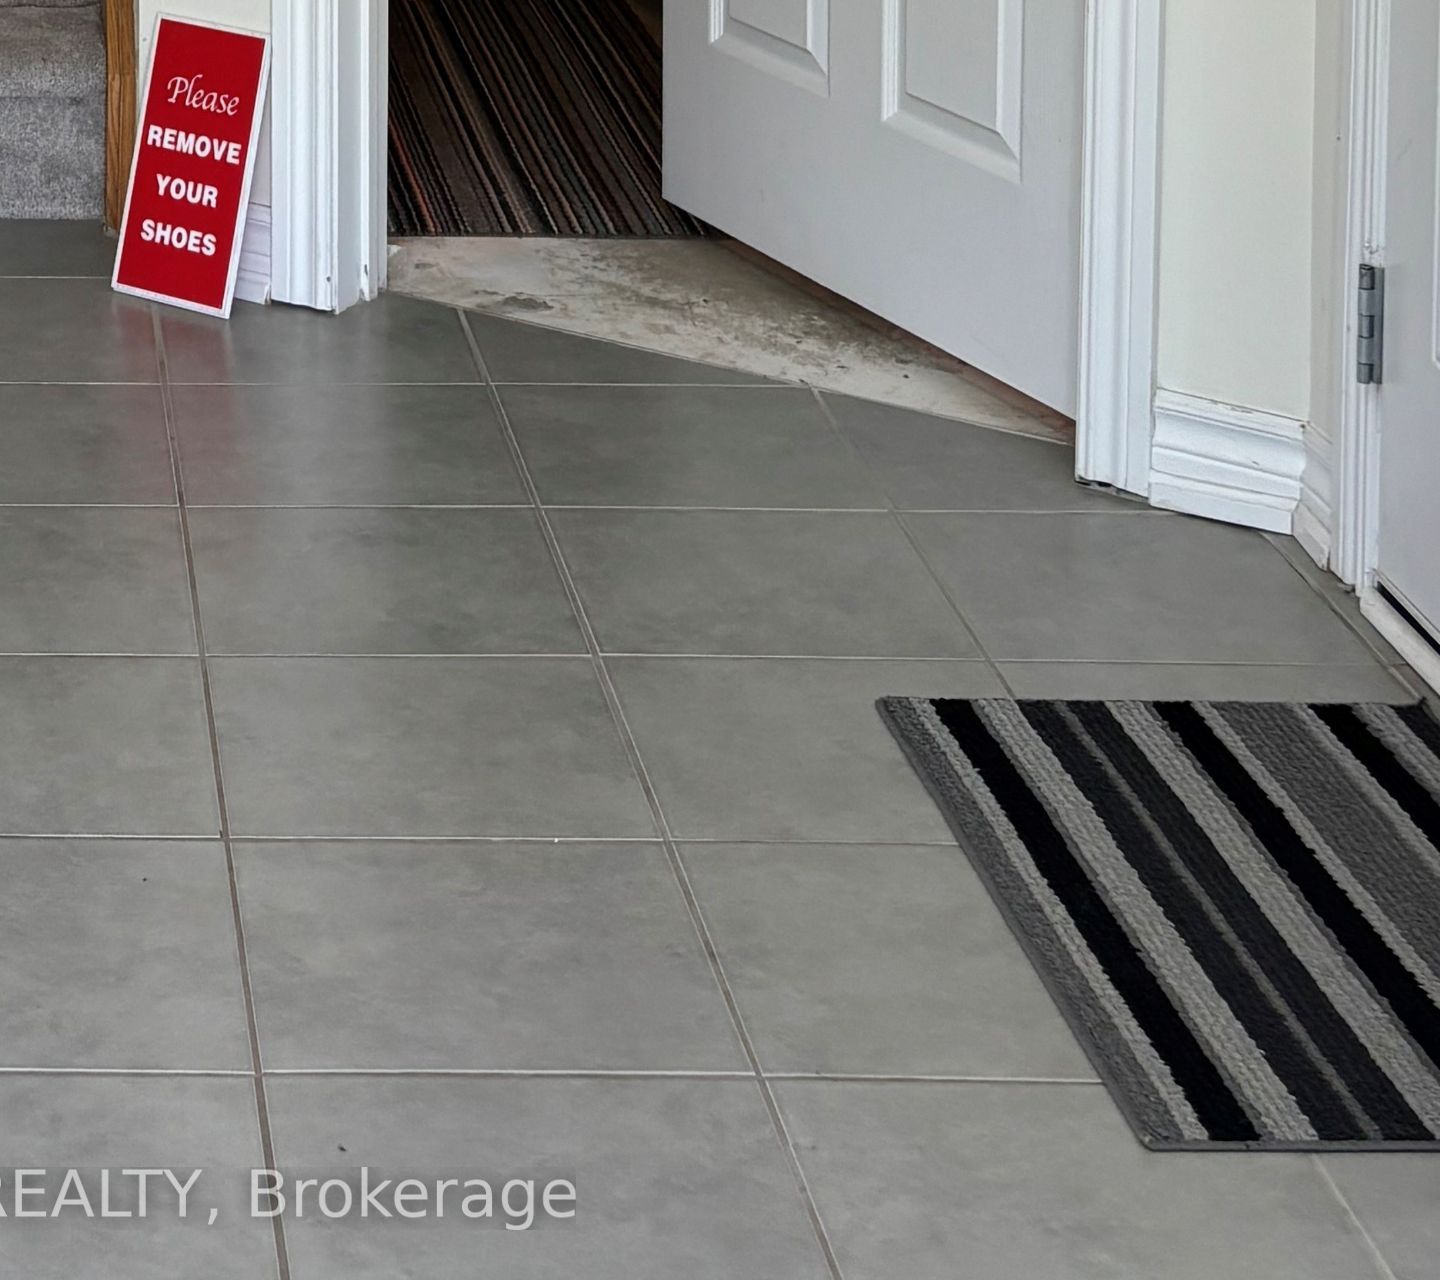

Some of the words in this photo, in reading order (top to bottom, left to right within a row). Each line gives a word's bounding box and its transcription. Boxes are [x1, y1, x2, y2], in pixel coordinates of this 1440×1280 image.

[166, 73, 240, 116] Please
[146, 124, 242, 165] REMOVE
[156, 173, 219, 209] YOUR
[140, 218, 217, 257] SHOES
